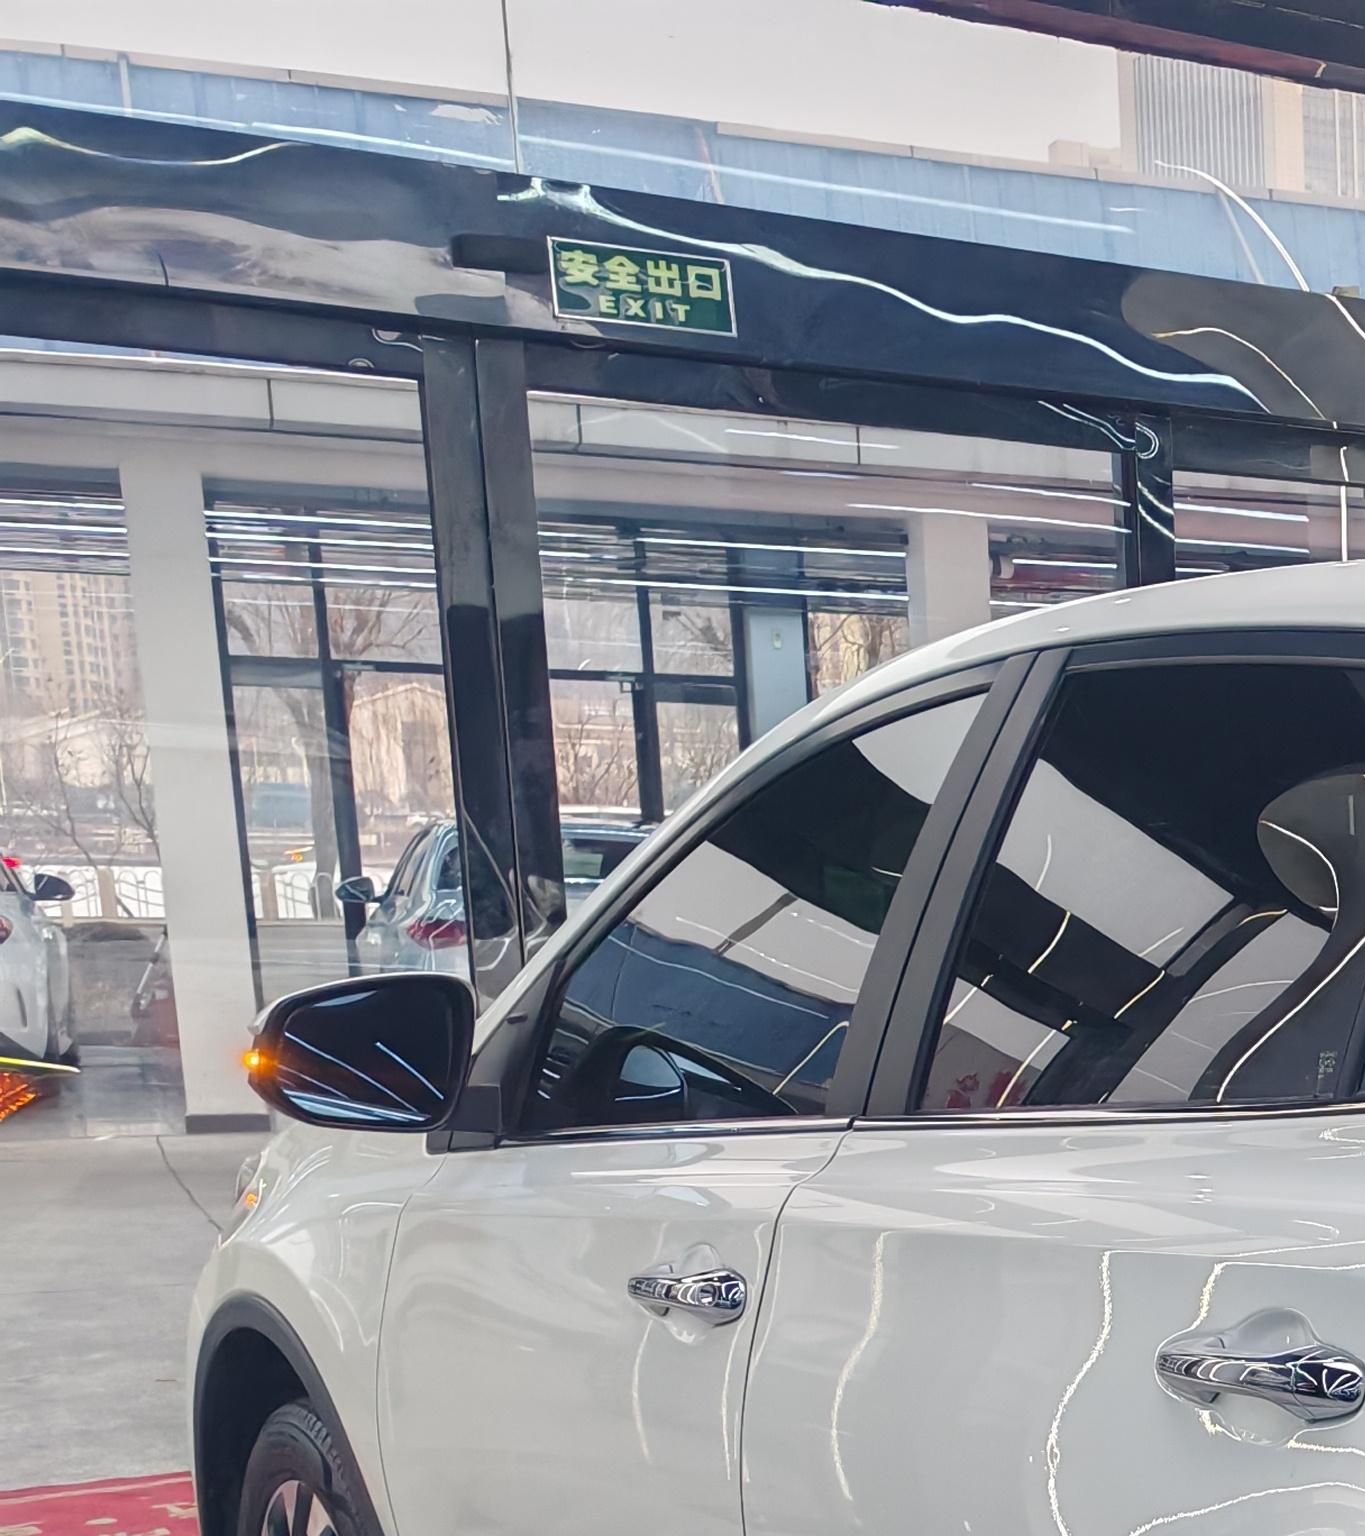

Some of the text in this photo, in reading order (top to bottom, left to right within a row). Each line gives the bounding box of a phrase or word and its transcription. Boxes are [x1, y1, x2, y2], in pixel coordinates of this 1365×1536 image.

[559, 250, 722, 301] 安全出口
[599, 295, 690, 322] EXIT
